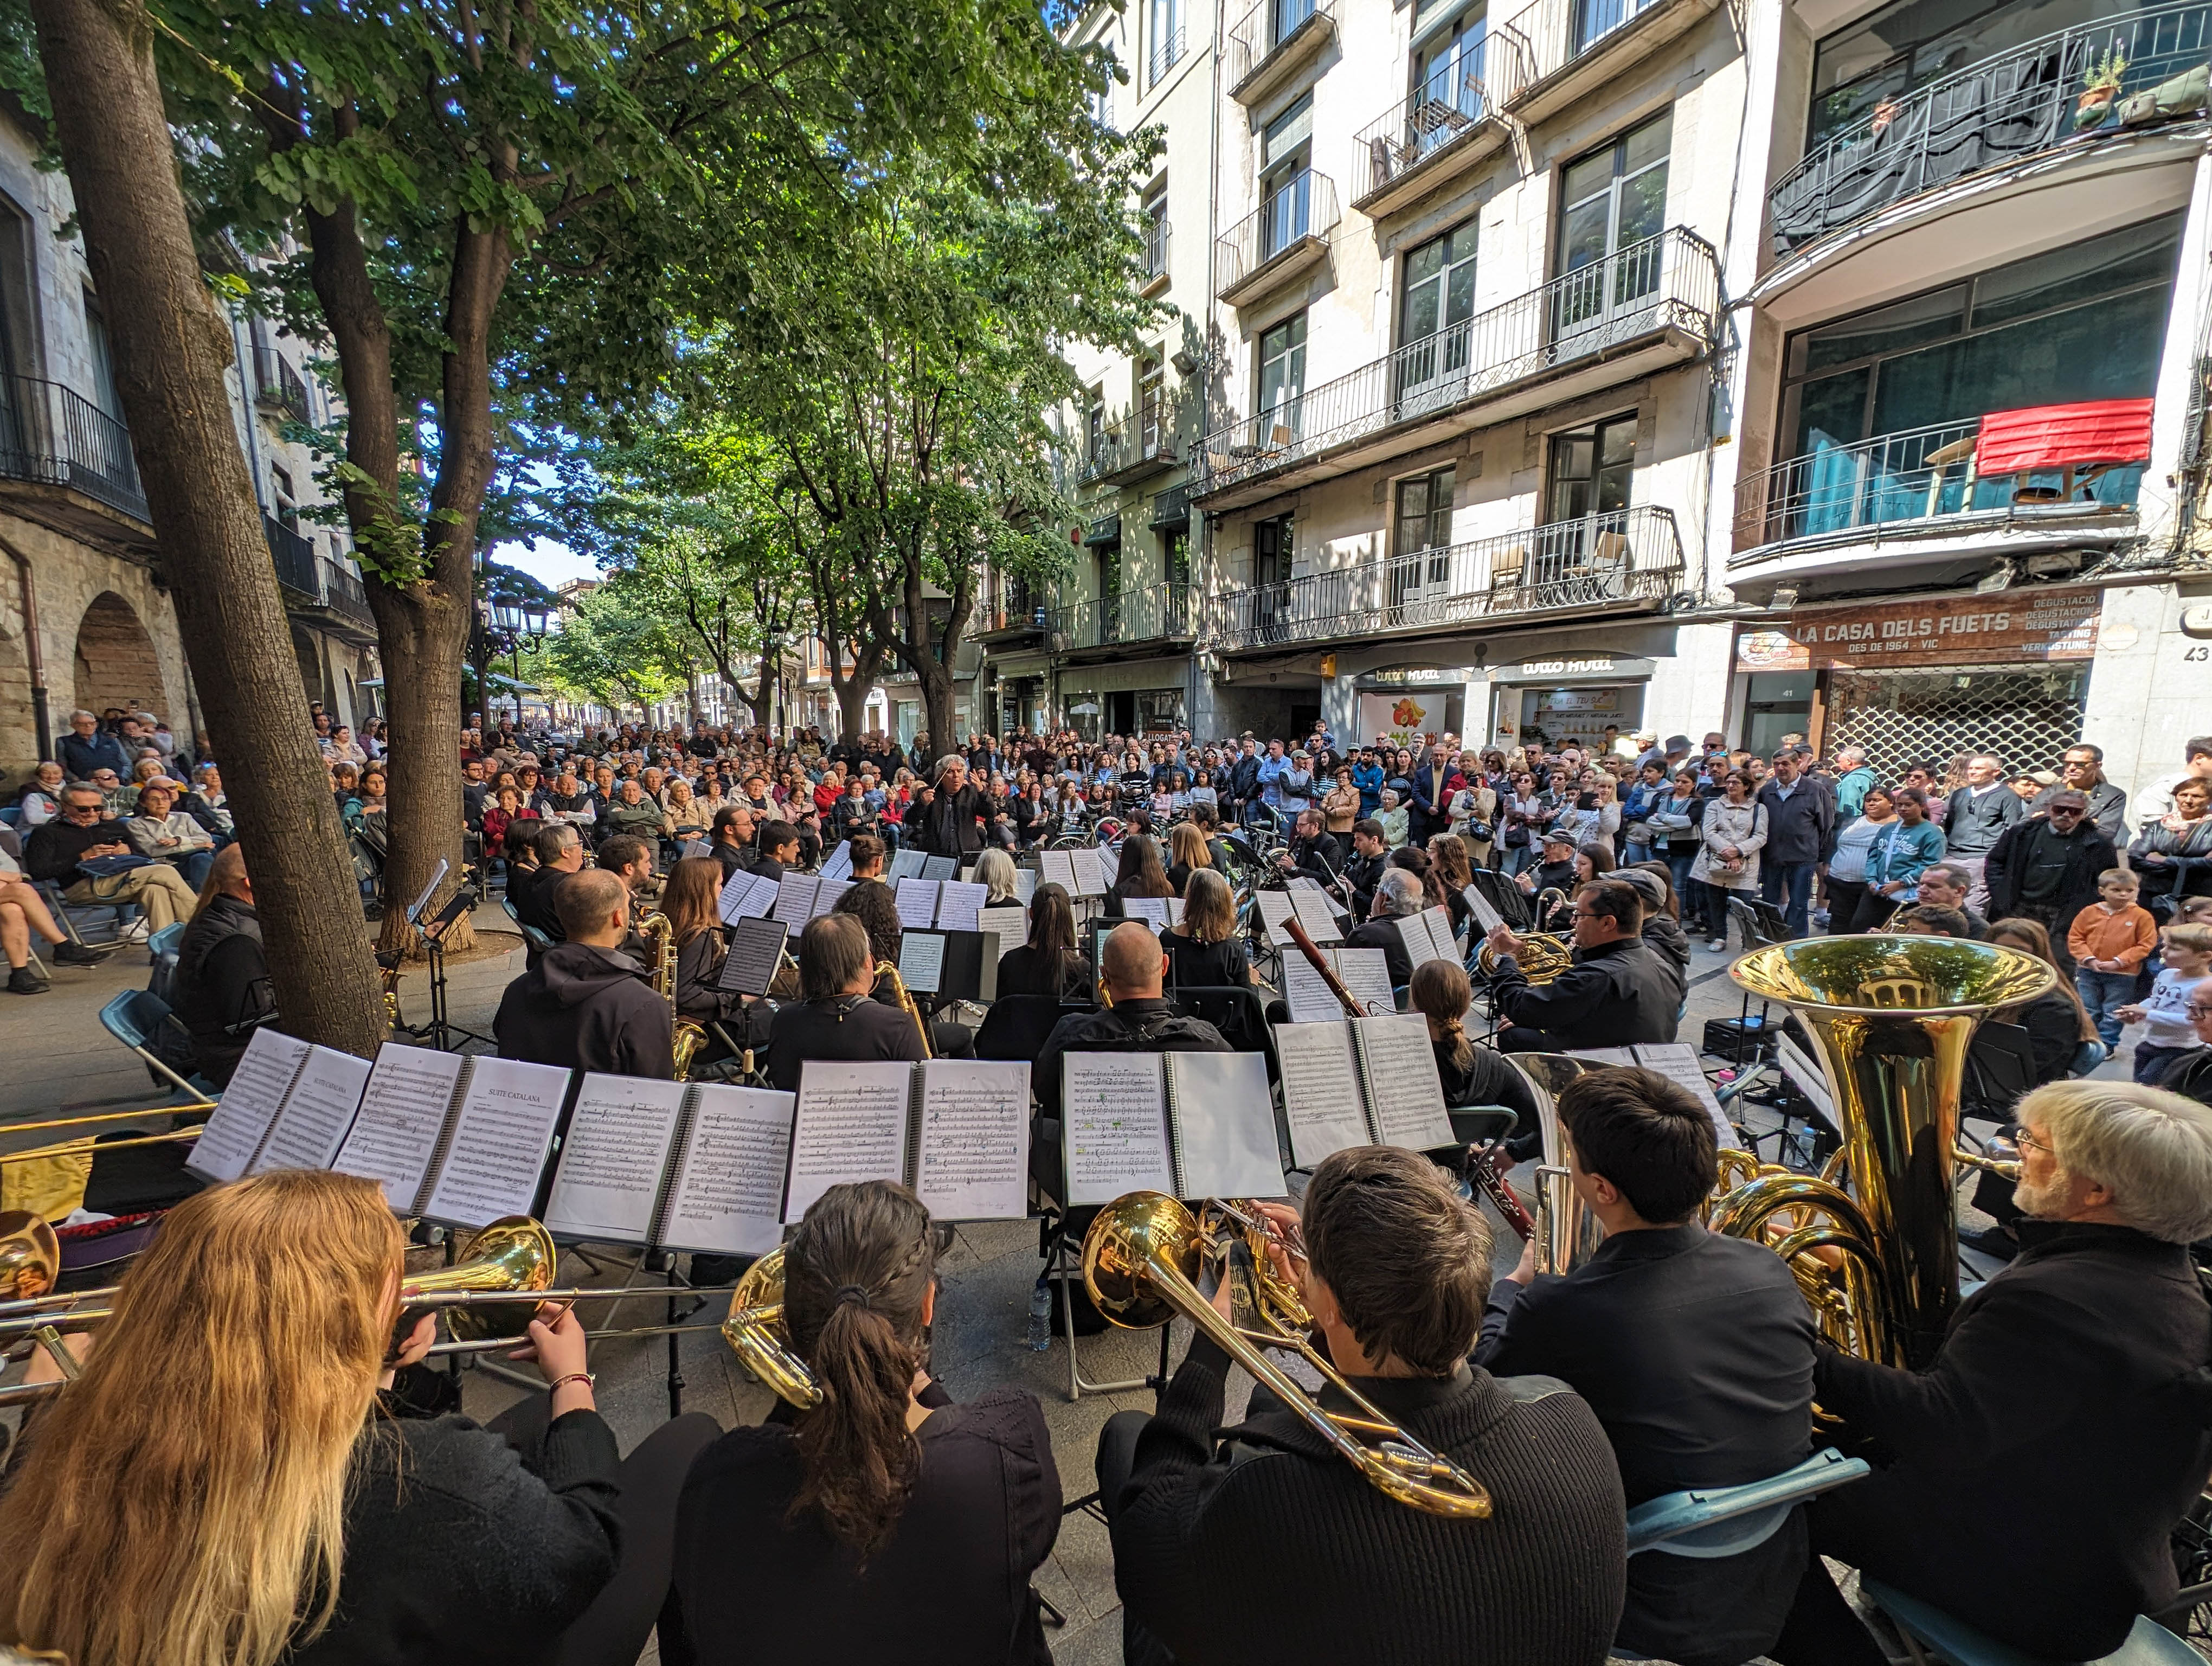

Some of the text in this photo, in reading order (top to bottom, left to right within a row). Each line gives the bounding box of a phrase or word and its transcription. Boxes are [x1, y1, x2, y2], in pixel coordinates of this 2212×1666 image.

[1796, 612, 2010, 643] LA CASA DELS FUETS
[2049, 629, 2091, 639] TASTING
[1849, 643, 1867, 653] DES
[1870, 642, 1883, 652] DE
[1886, 640, 1909, 651] 1964
[1921, 639, 1938, 649] VIC
[2021, 640, 2089, 651] VERKOSTUNG
[2184, 646, 2209, 662] 43
[1148, 733, 1172, 742] LLOGAT
[488, 1088, 507, 1097] SUITE
[507, 1092, 540, 1103] CATALANA
